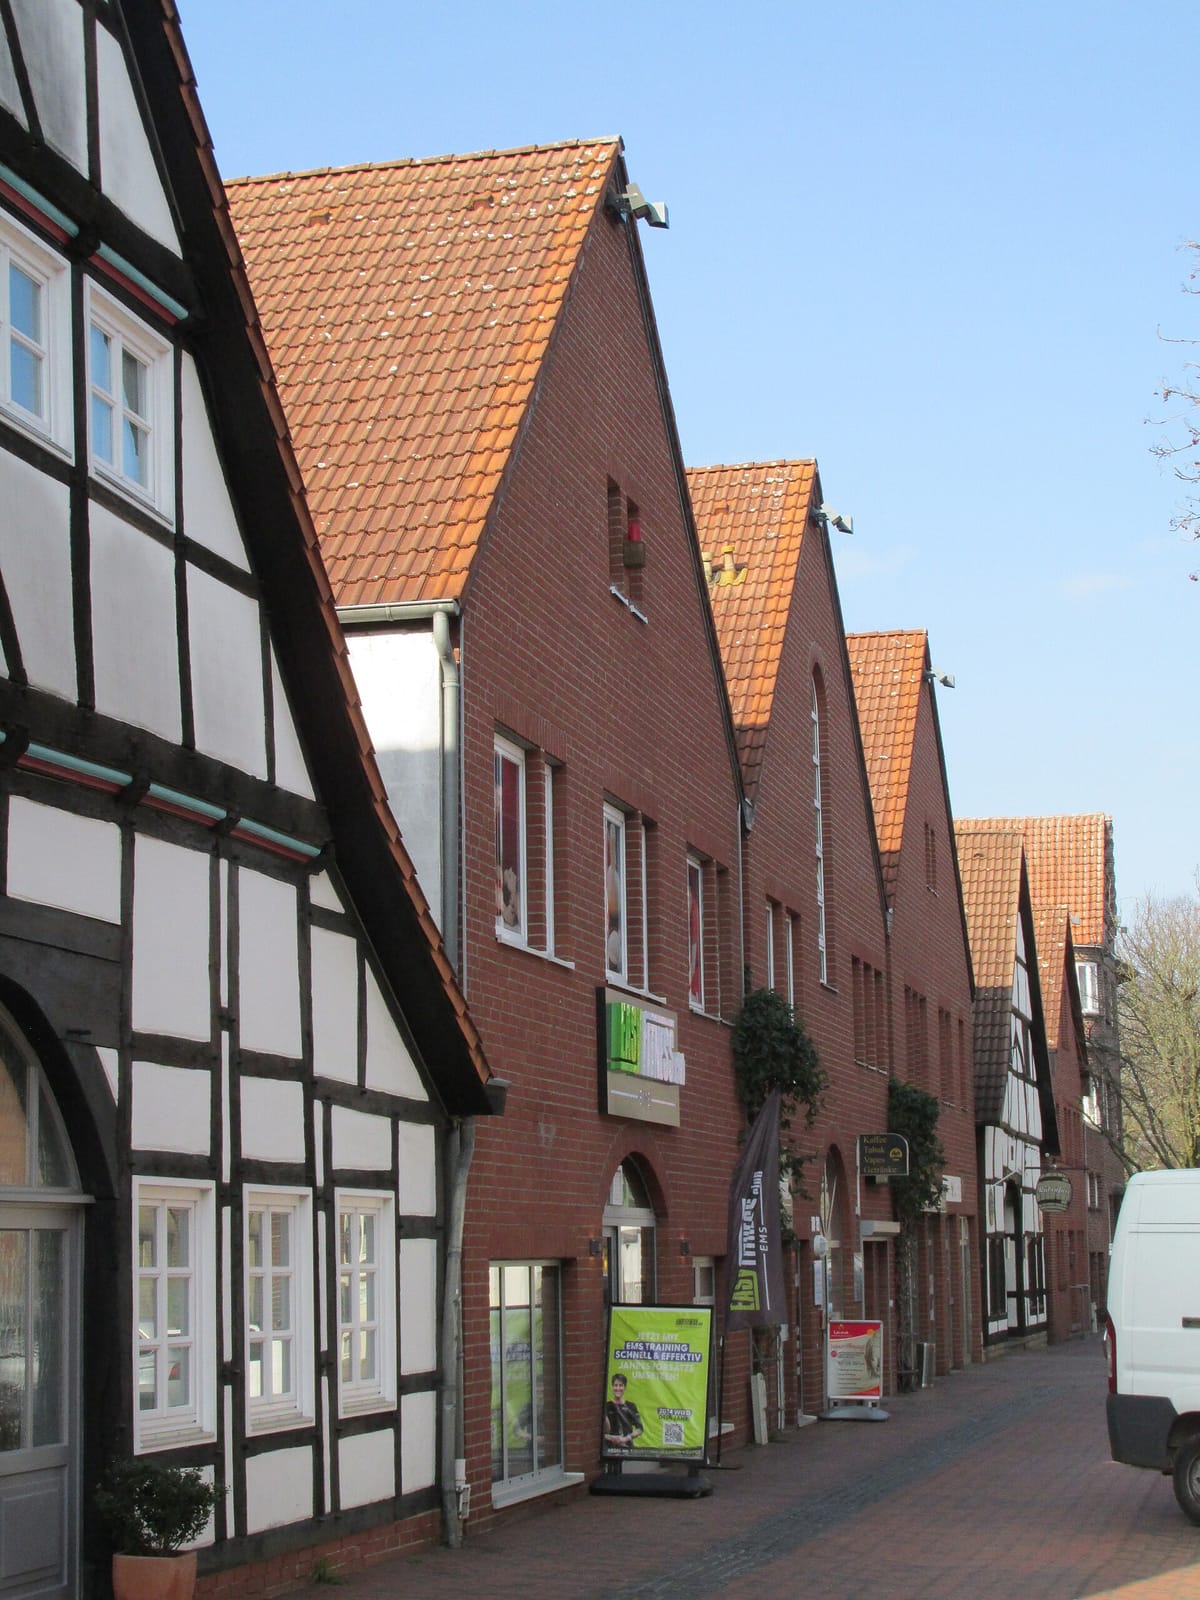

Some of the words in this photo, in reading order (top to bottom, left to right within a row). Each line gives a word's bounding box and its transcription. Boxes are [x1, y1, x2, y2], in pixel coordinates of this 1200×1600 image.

[758, 1226, 769, 1252] EMS
[626, 1342, 644, 1351] EMS
[645, 1343, 688, 1352] TRAINING
[615, 1350, 653, 1360] SCHNELL
[661, 1352, 702, 1362] EFFEKTIV
